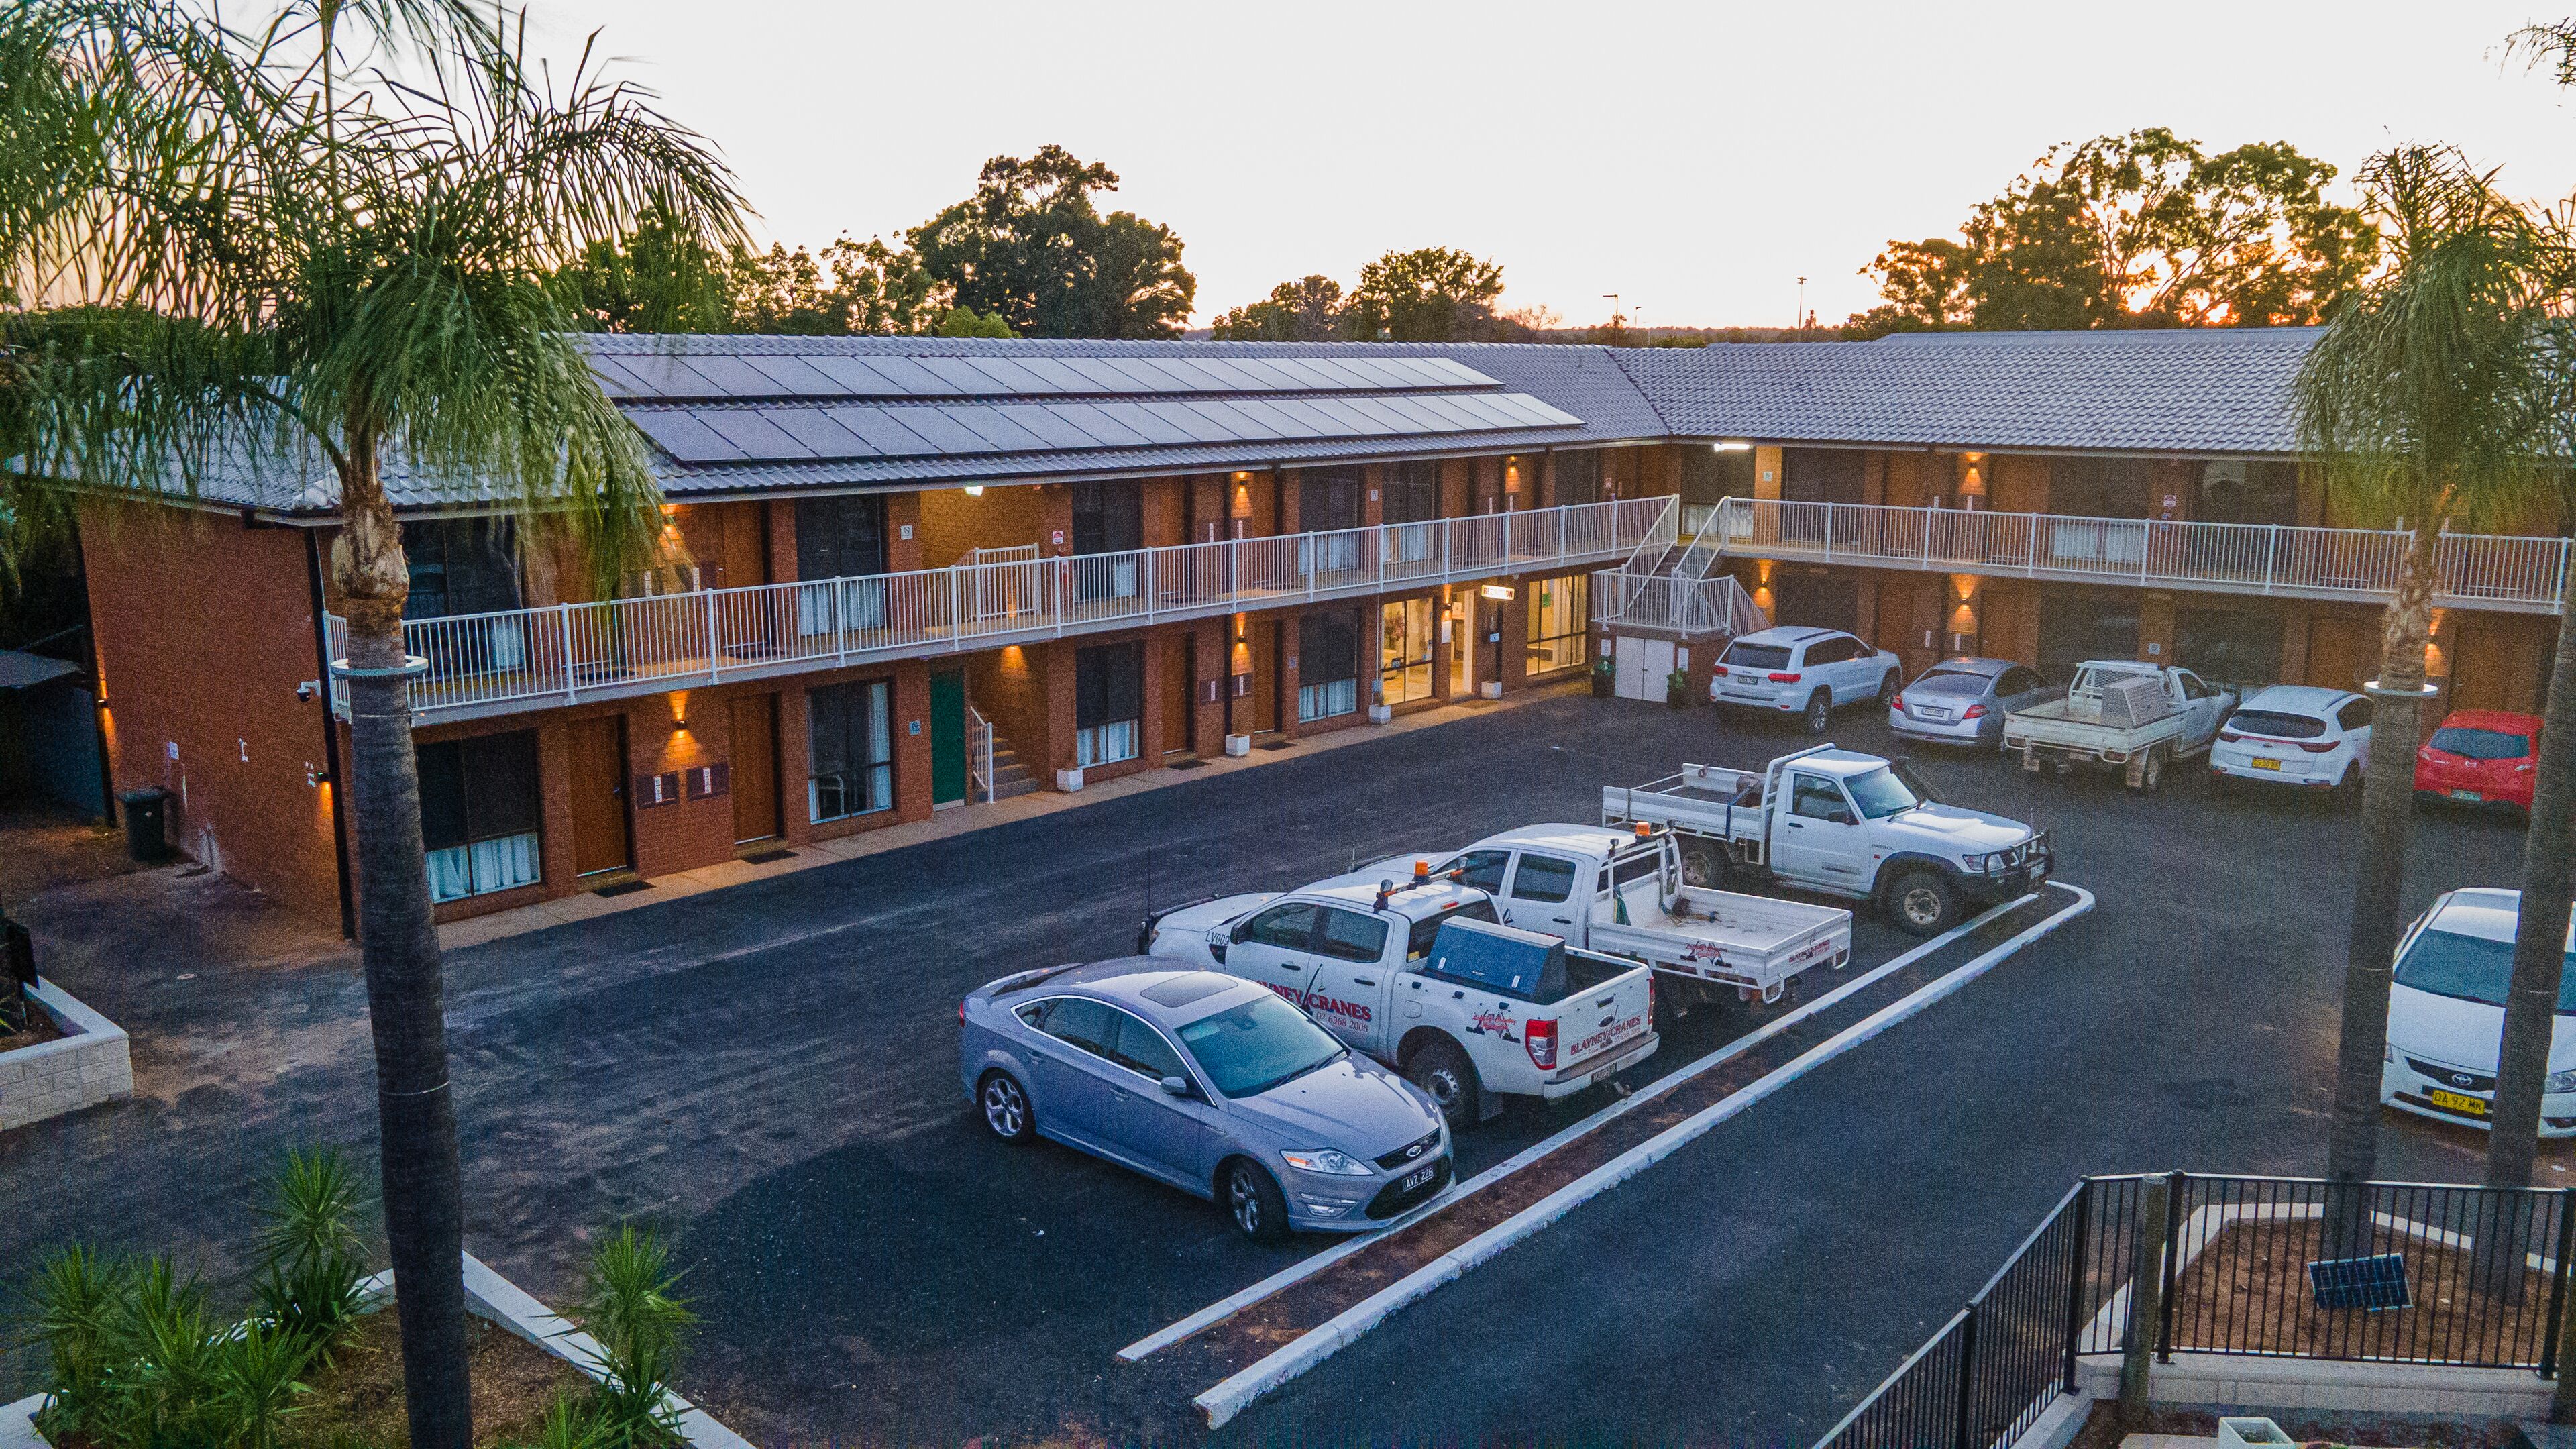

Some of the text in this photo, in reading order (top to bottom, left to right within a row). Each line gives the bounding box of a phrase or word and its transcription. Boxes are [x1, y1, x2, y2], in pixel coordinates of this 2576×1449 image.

[1205, 931, 1230, 946] LV009
[1309, 993, 1372, 1021] CRANES
[1328, 1015, 1346, 1027] 6368
[1349, 1020, 1368, 1033] 2008
[1570, 1030, 1609, 1055] BLAYNEY
[1611, 1015, 1641, 1036] CRANES
[2434, 1092, 2448, 1104] DA
[2451, 1096, 2465, 1108] 92
